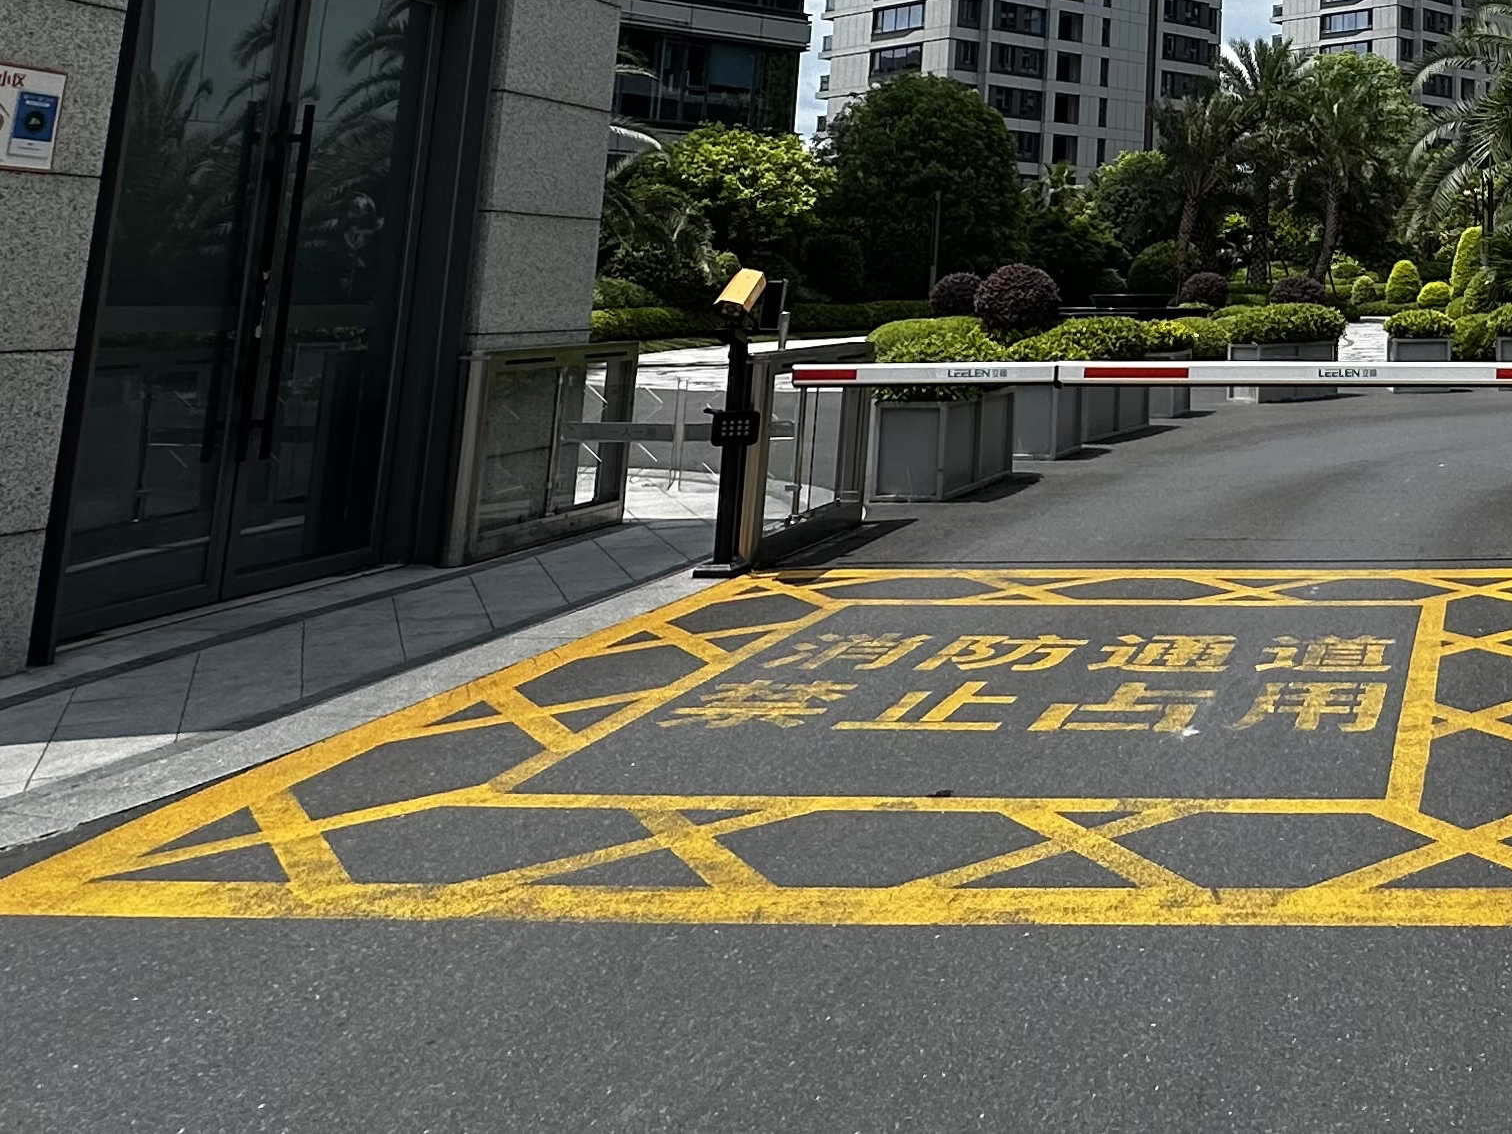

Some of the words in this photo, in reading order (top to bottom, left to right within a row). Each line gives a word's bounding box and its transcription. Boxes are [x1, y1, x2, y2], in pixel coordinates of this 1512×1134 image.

[763, 633, 1396, 672] 消防通道
[656, 680, 1389, 733] 禁止占用
